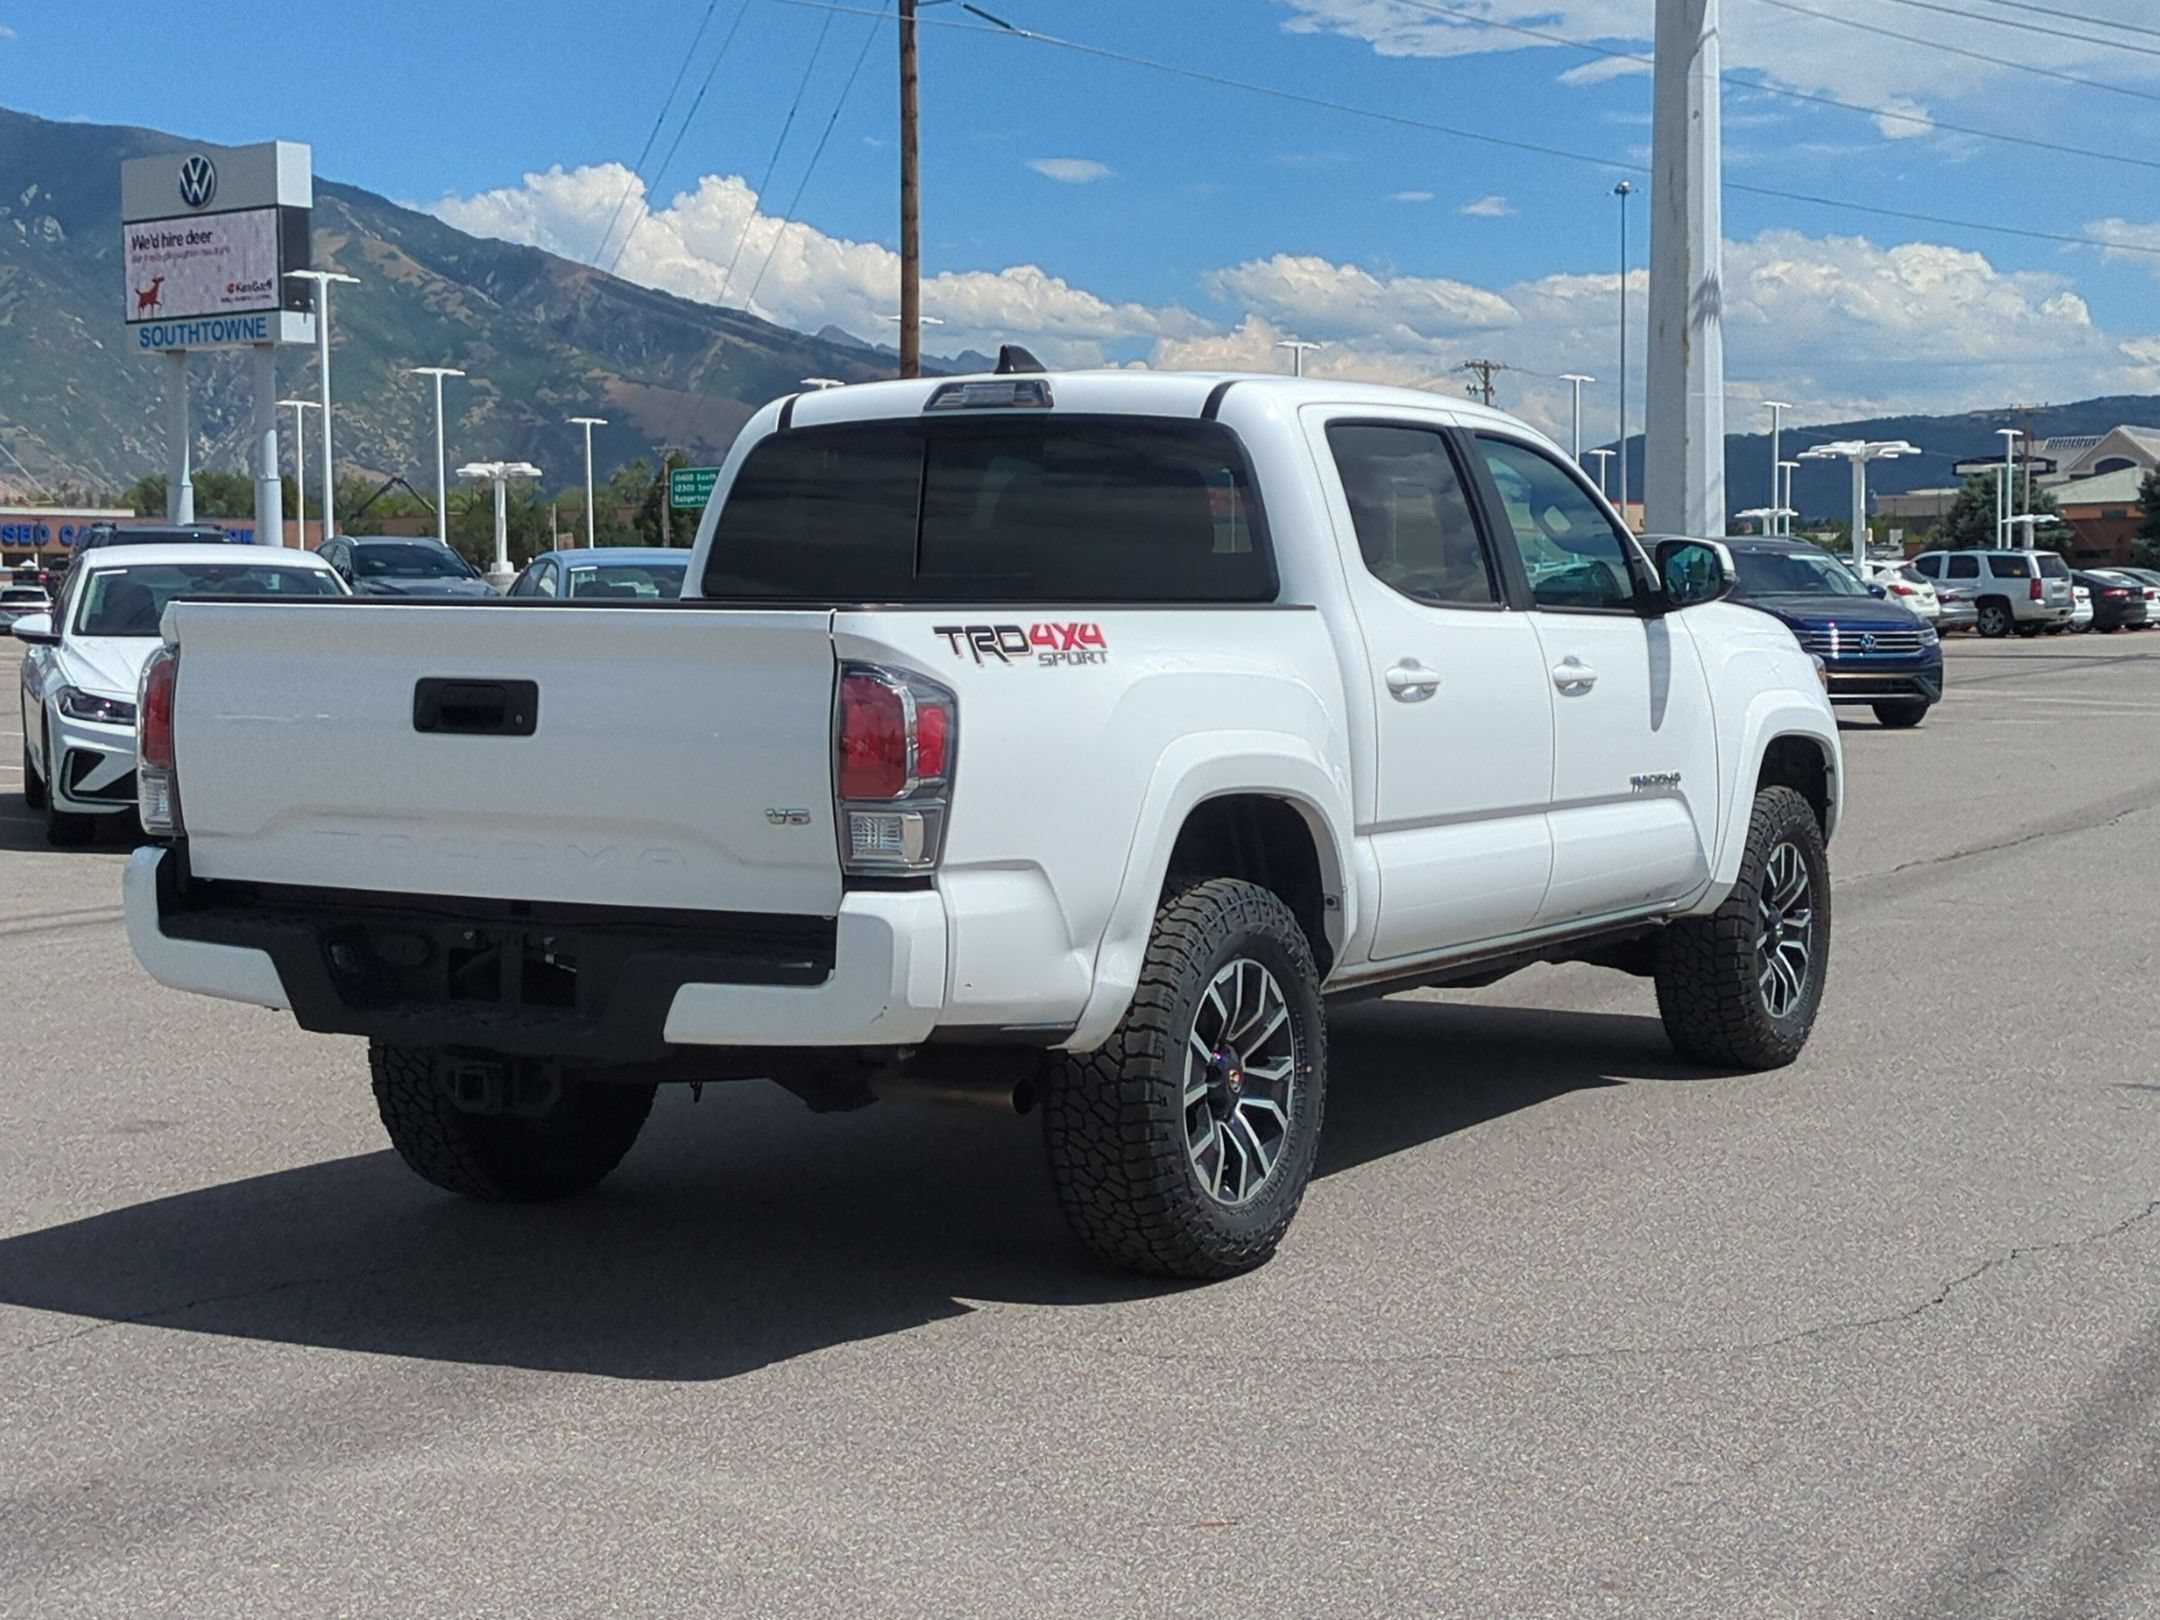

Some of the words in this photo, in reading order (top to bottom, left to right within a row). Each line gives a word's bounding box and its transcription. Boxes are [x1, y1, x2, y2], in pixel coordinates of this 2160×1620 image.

[161, 232, 184, 249] hire
[186, 230, 213, 247] deer
[139, 317, 267, 348] SOUTHTOWNE
[0, 524, 50, 546] SED
[932, 625, 1032, 666] TRD
[1038, 650, 1109, 667] SPORT
[765, 808, 811, 825] V6
